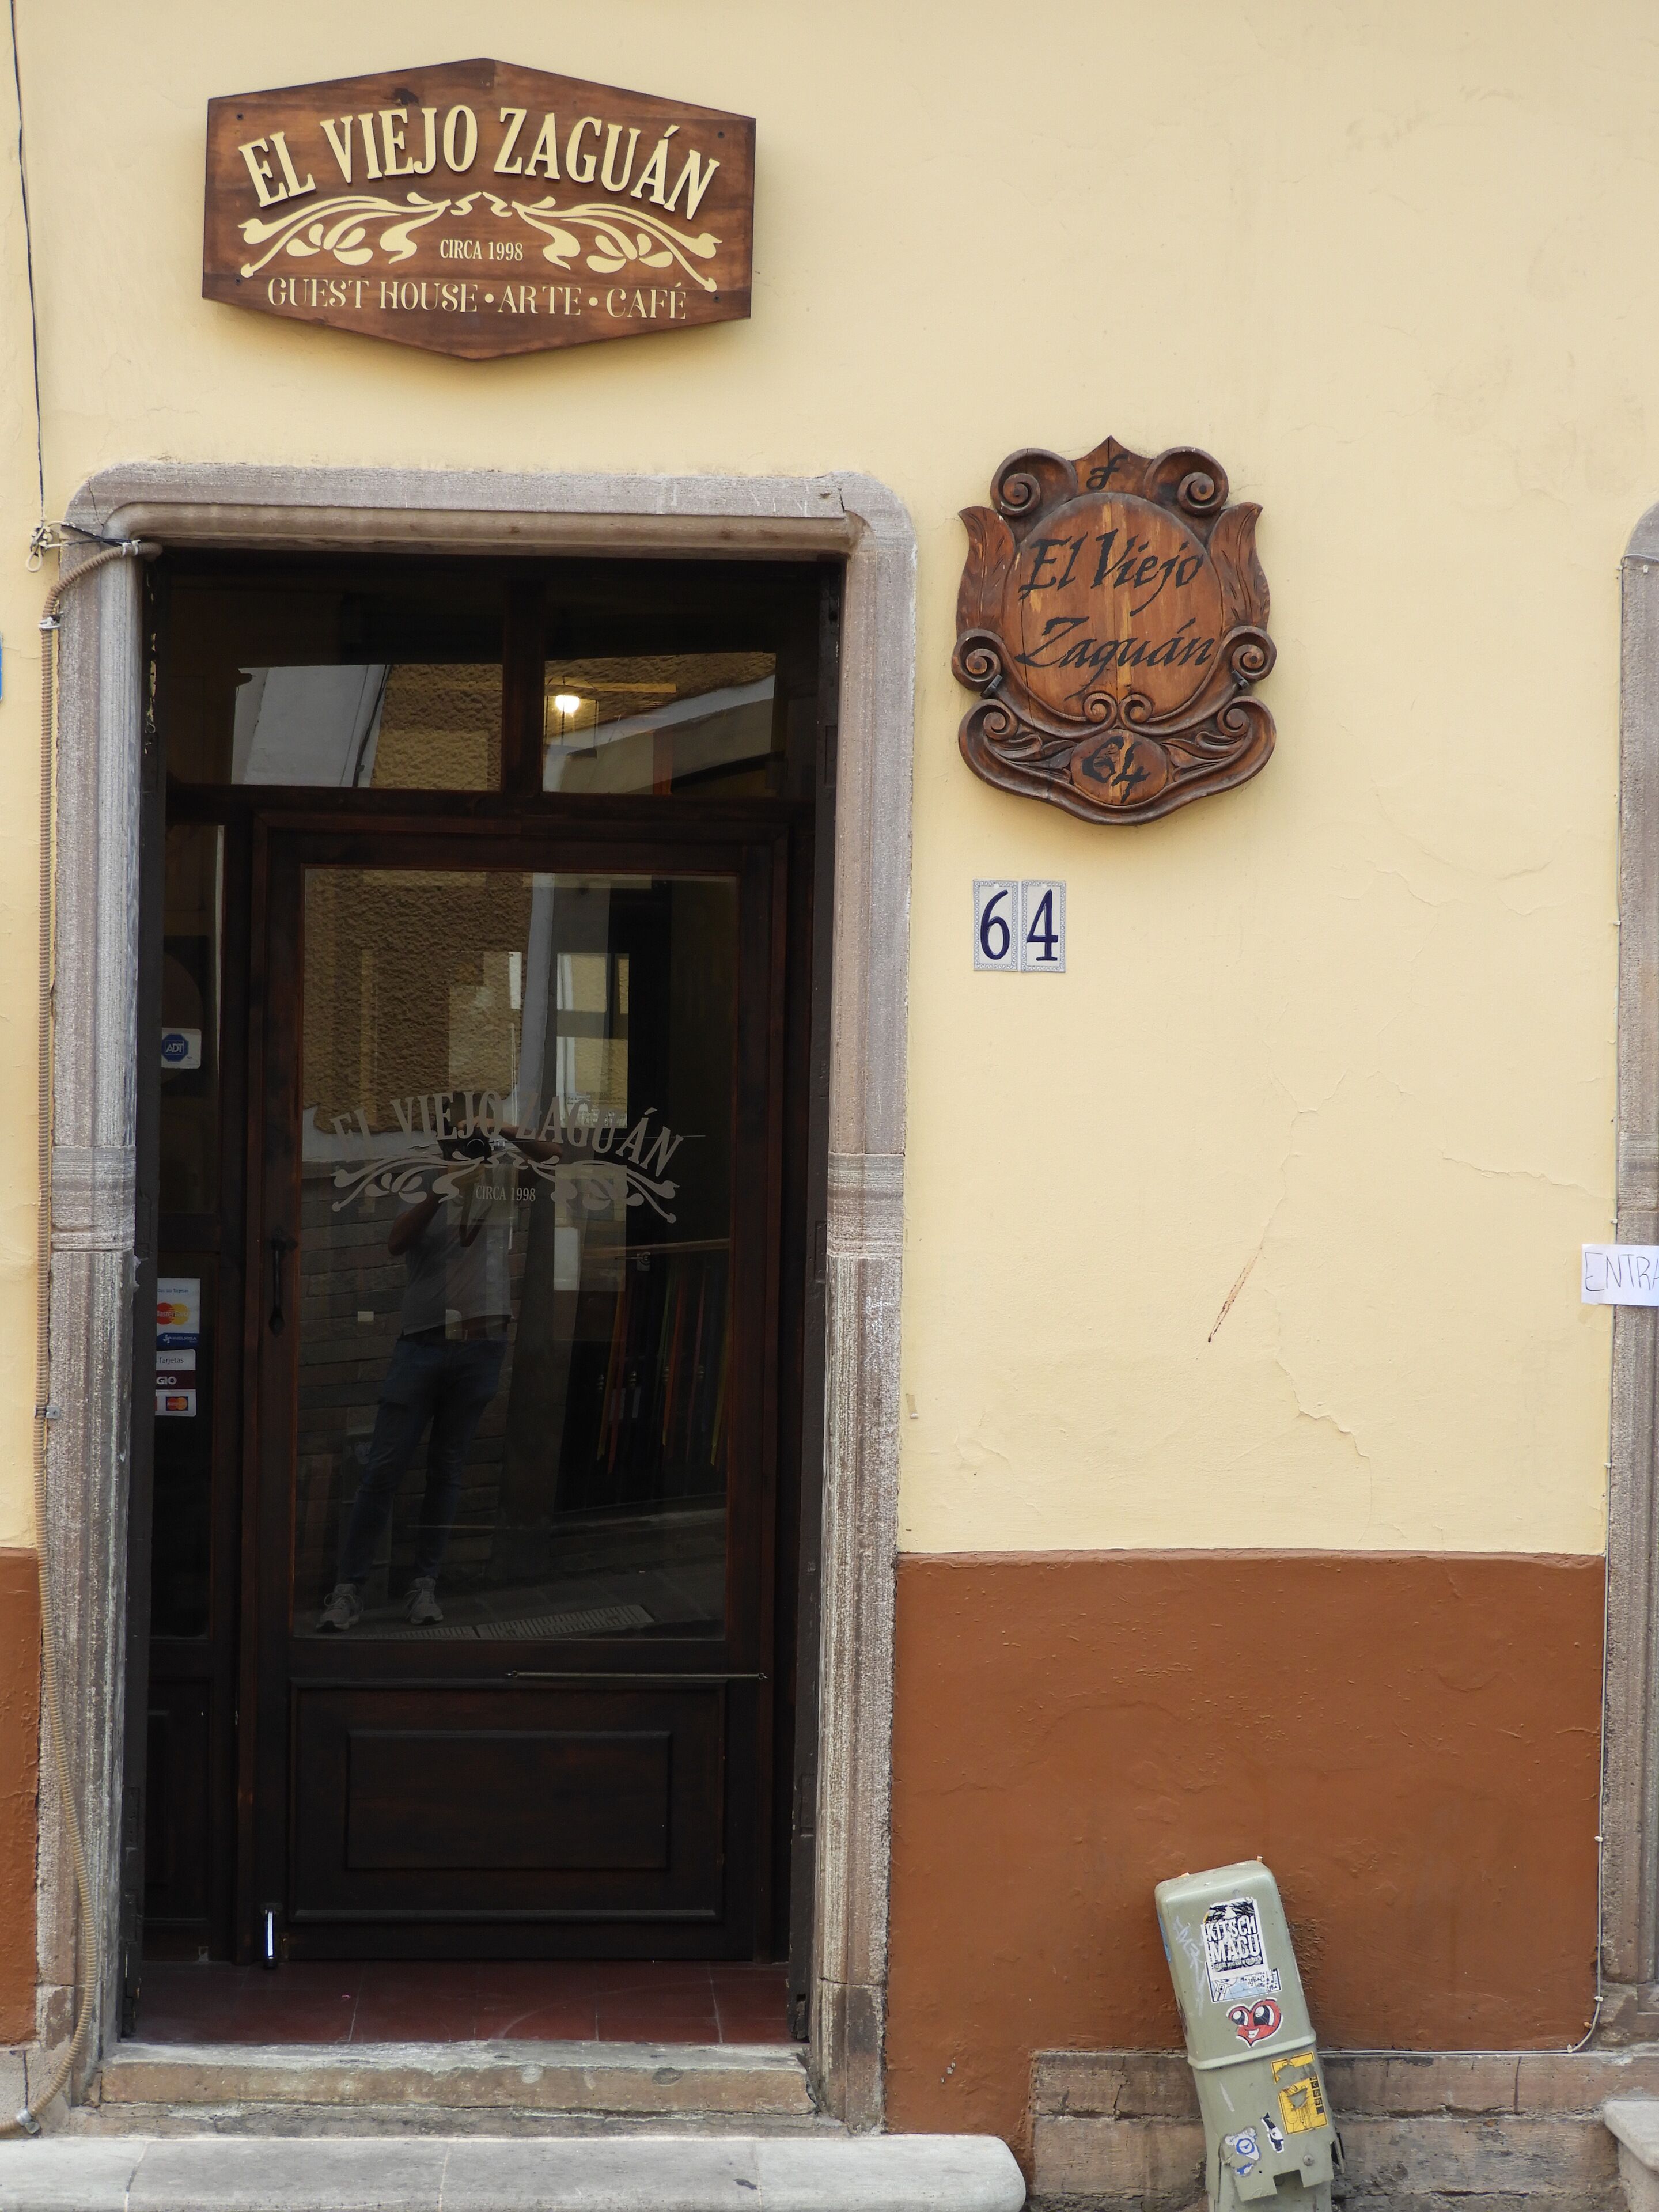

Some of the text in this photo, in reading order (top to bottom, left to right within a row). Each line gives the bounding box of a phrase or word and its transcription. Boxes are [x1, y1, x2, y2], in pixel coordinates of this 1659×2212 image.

[238, 105, 721, 221] EL VIEJO ZAGUÁN
[440, 239, 524, 262] CIRCA 1998
[268, 277, 687, 320] GUEST HOUSE ARTE CAFÉ
[1018, 528, 1204, 617] El Viejo
[1016, 616, 1216, 701] Zaguán
[1082, 736, 1151, 803] 64
[980, 889, 1059, 961] 64
[165, 1043, 184, 1053] ADT
[391, 1089, 504, 1142] VIEJO
[516, 1092, 684, 1177] ZAGUÁN
[475, 1185, 536, 1202] CIRCA 1998
[1205, 1915, 1258, 1941] KITSCH
